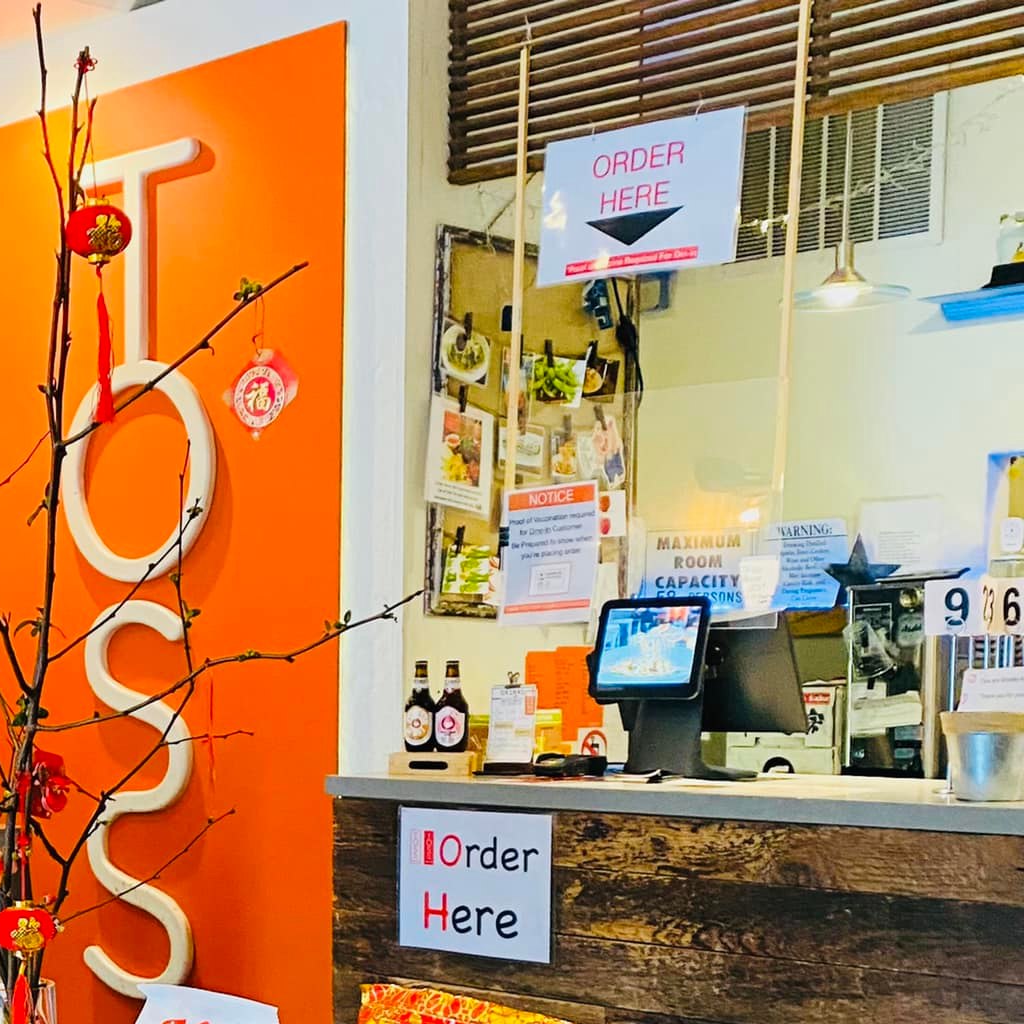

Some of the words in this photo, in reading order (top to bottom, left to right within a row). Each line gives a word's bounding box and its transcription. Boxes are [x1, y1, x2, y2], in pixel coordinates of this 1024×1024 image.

[593, 141, 685, 179] ORDER
[600, 181, 671, 215] HERE
[245, 381, 271, 413] 福
[528, 488, 575, 506] NOTICE
[657, 534, 741, 551] MAXIMUM
[674, 555, 723, 569] ROOM
[655, 574, 740, 589] CAPACITY
[944, 588, 970, 626] 9
[1003, 587, 1021, 627] 6
[439, 834, 539, 873] Order
[423, 890, 519, 939] Here
